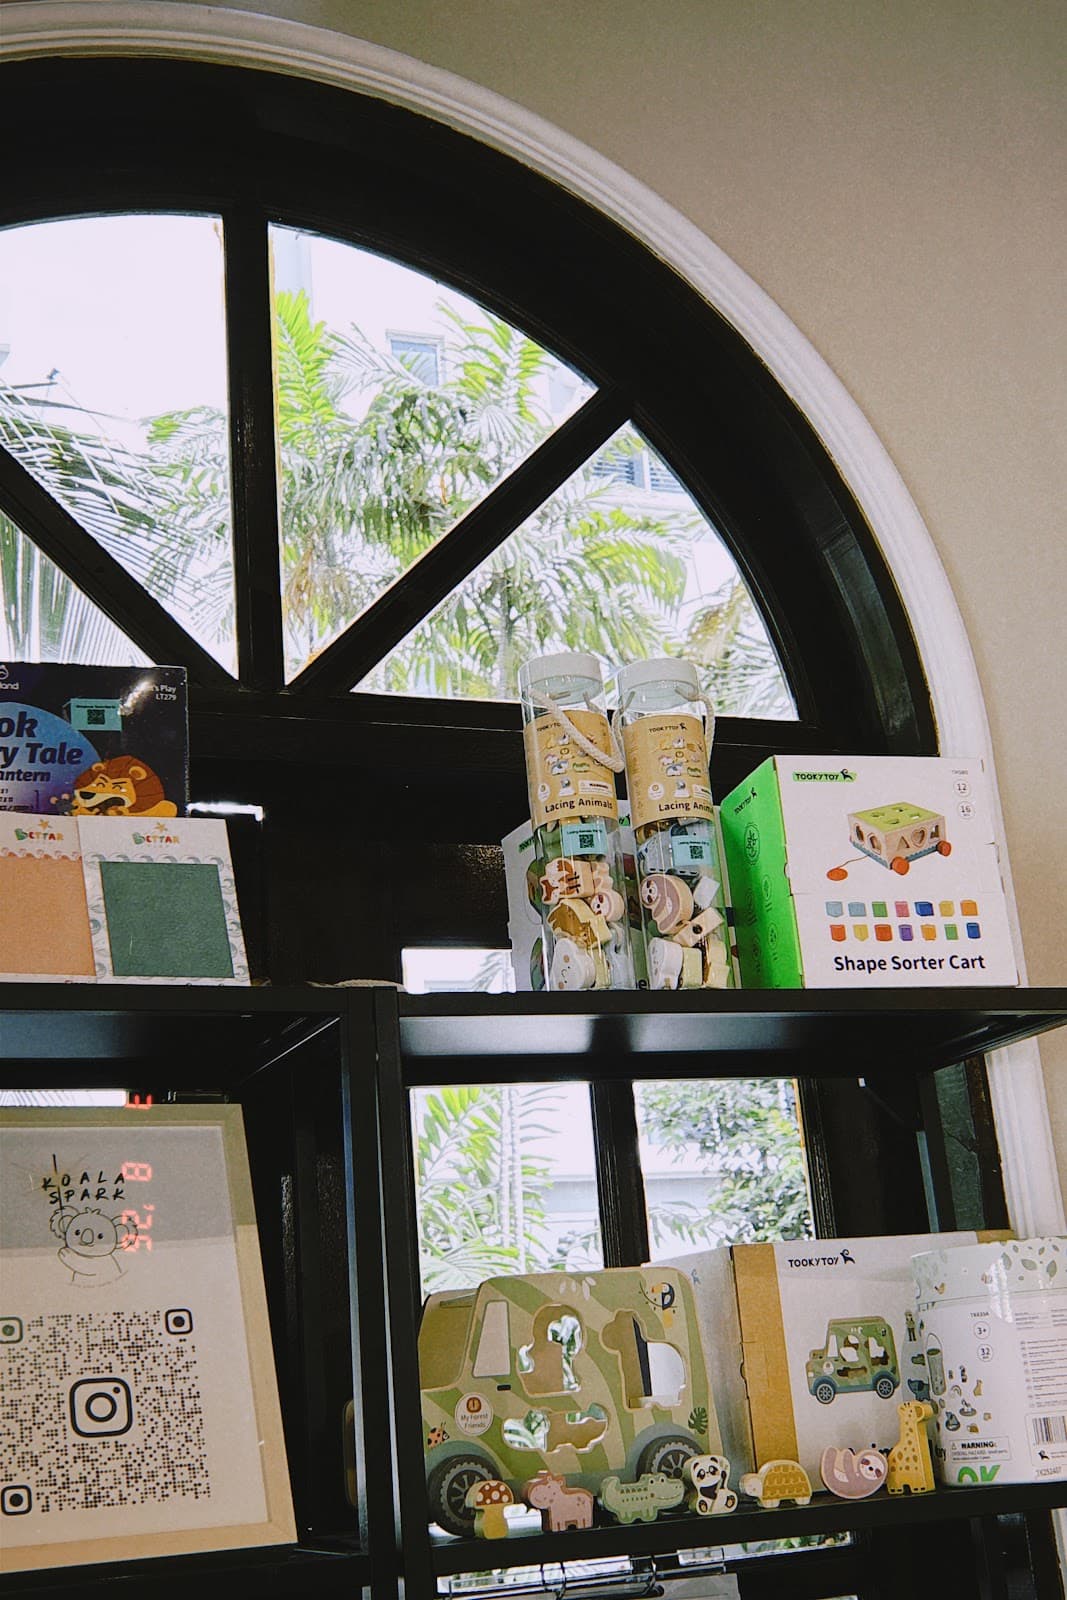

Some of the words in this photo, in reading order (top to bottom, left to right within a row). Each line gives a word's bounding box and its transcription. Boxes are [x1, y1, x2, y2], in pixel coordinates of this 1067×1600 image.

[25, 742, 83, 765] Tale
[795, 773, 840, 781] TOOKYTOY
[545, 799, 575, 813] Lacing
[578, 798, 613, 810] Animals
[658, 801, 690, 812] Lacing
[834, 956, 887, 974] Shape
[891, 955, 945, 970] Sorter
[949, 955, 986, 970] Cart
[42, 1170, 125, 1190] KOALA
[49, 1188, 126, 1204] SPARK
[788, 1256, 839, 1268] TOOKYTOY
